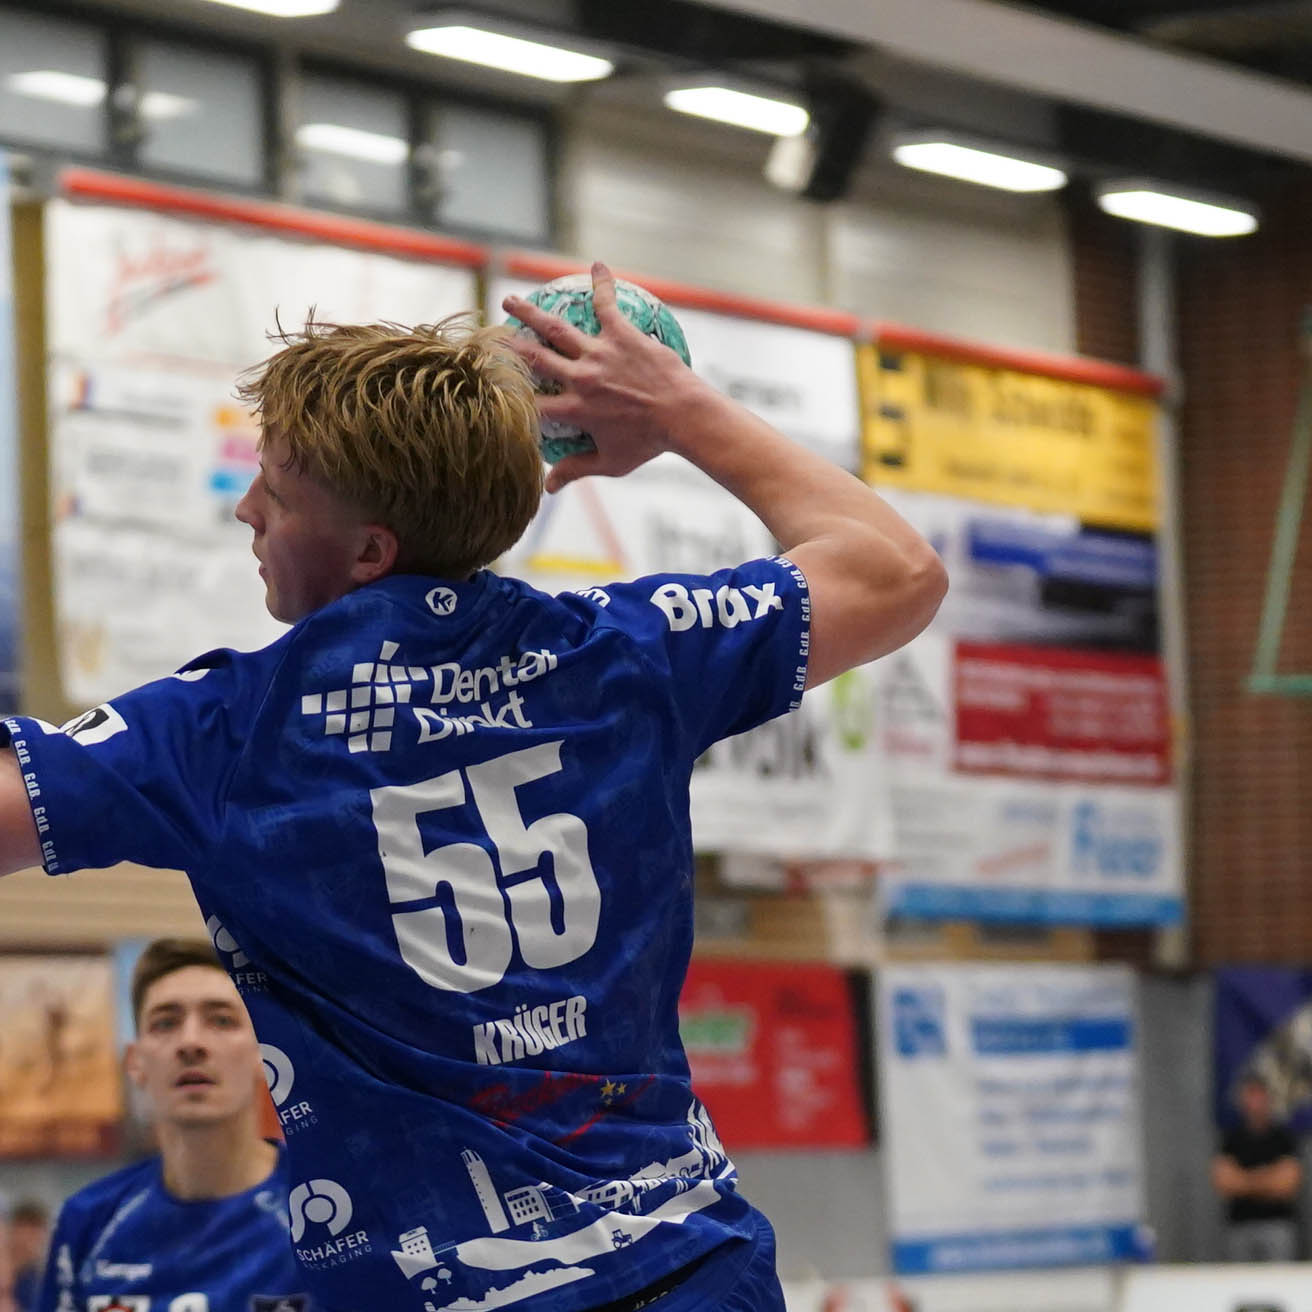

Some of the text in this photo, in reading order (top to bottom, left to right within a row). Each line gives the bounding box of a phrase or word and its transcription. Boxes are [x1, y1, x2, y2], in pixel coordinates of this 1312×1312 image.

[649, 581, 785, 632] Brax
[369, 739, 602, 994] 55
[473, 995, 588, 1066] KRÜGER
[296, 1230, 370, 1262] SCHÄFER
